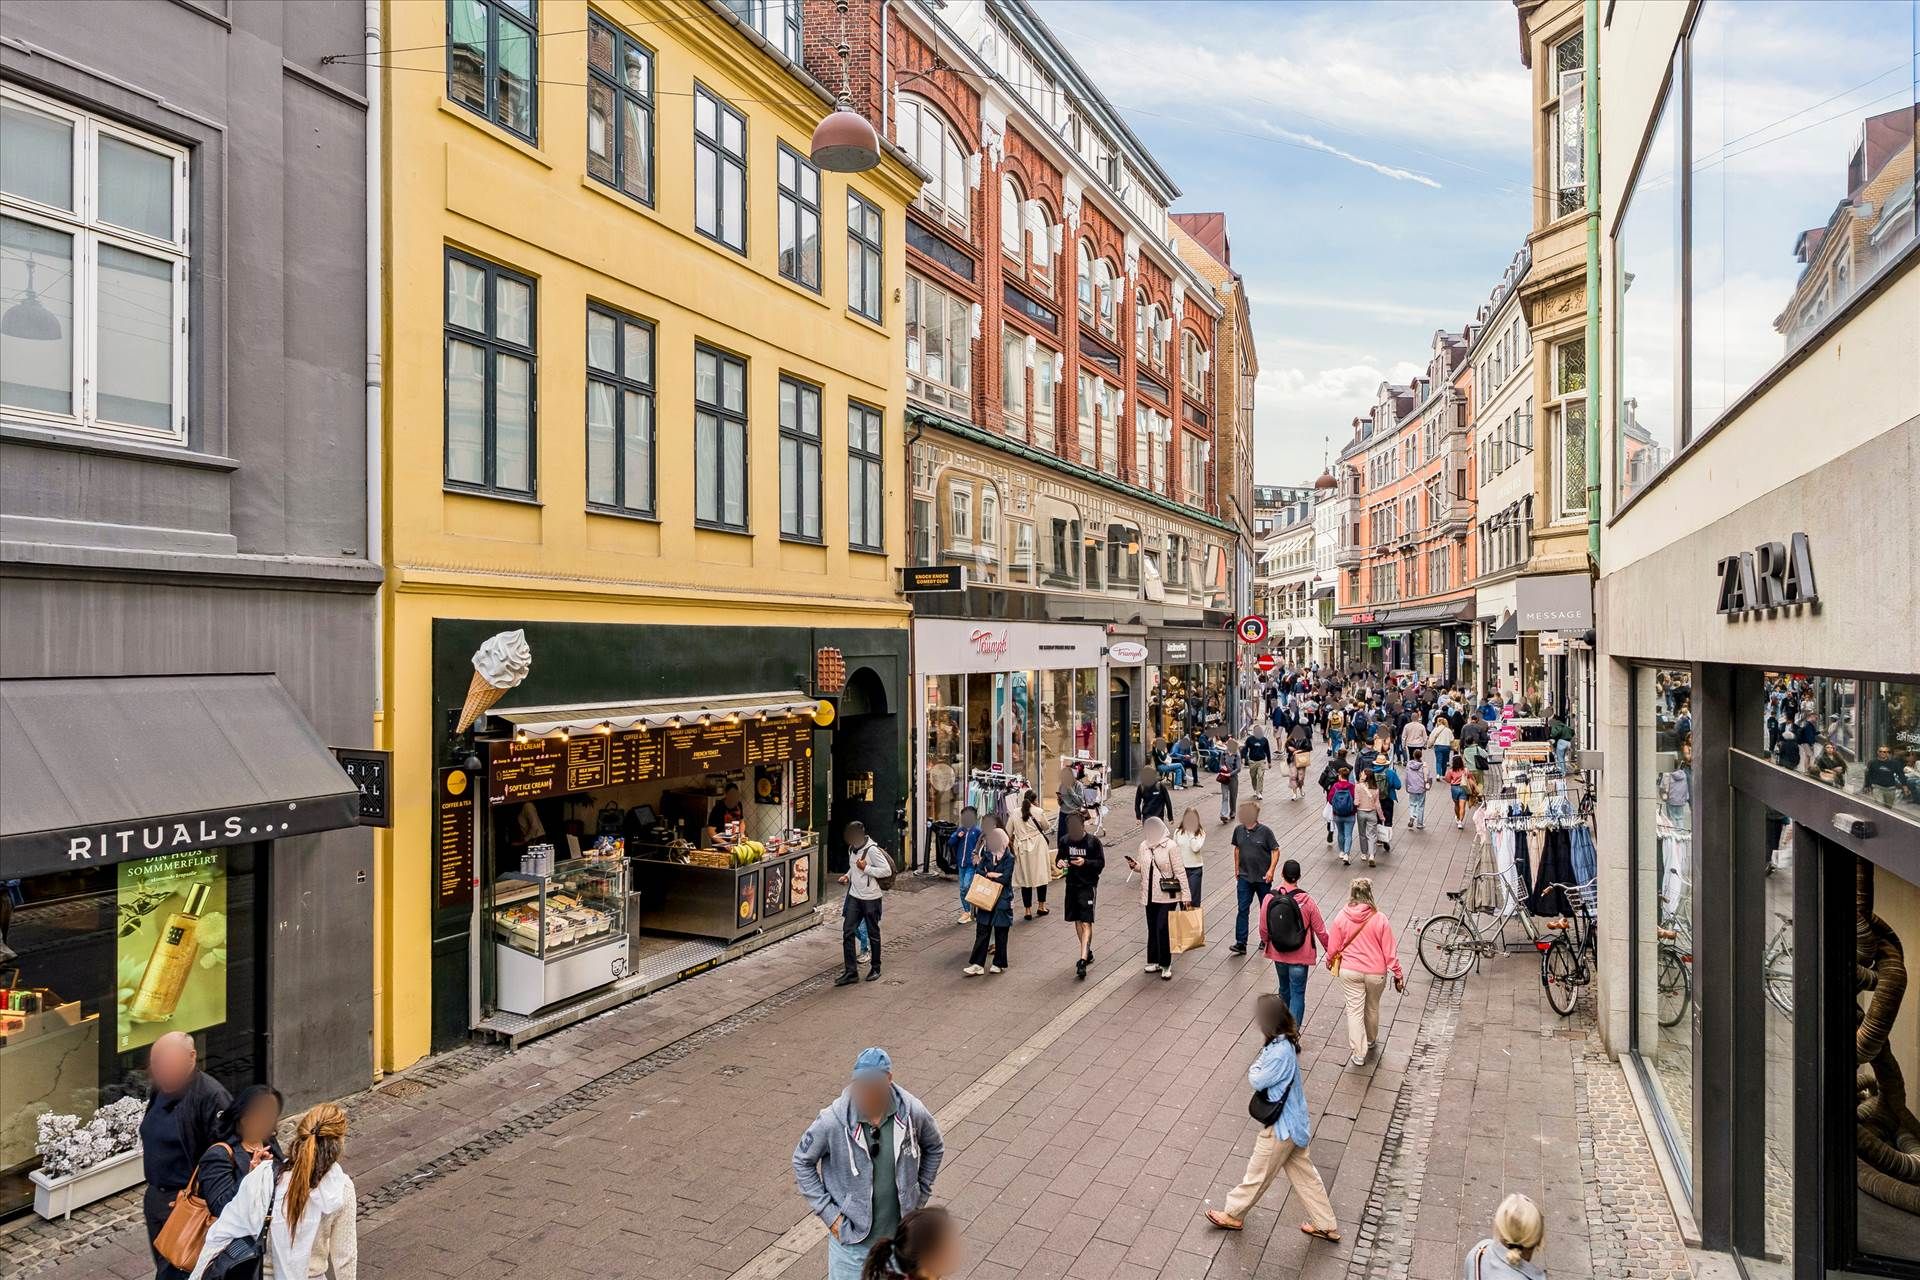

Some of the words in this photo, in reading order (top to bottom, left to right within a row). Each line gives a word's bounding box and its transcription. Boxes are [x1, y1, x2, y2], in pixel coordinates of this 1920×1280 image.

[1716, 532, 1821, 614] ZARA
[1526, 610, 1582, 620] MESSAGE
[970, 629, 1007, 662] Triumph
[1113, 647, 1143, 660] Triumph
[509, 784, 522, 792] SOFT
[532, 781, 549, 789] CREAM
